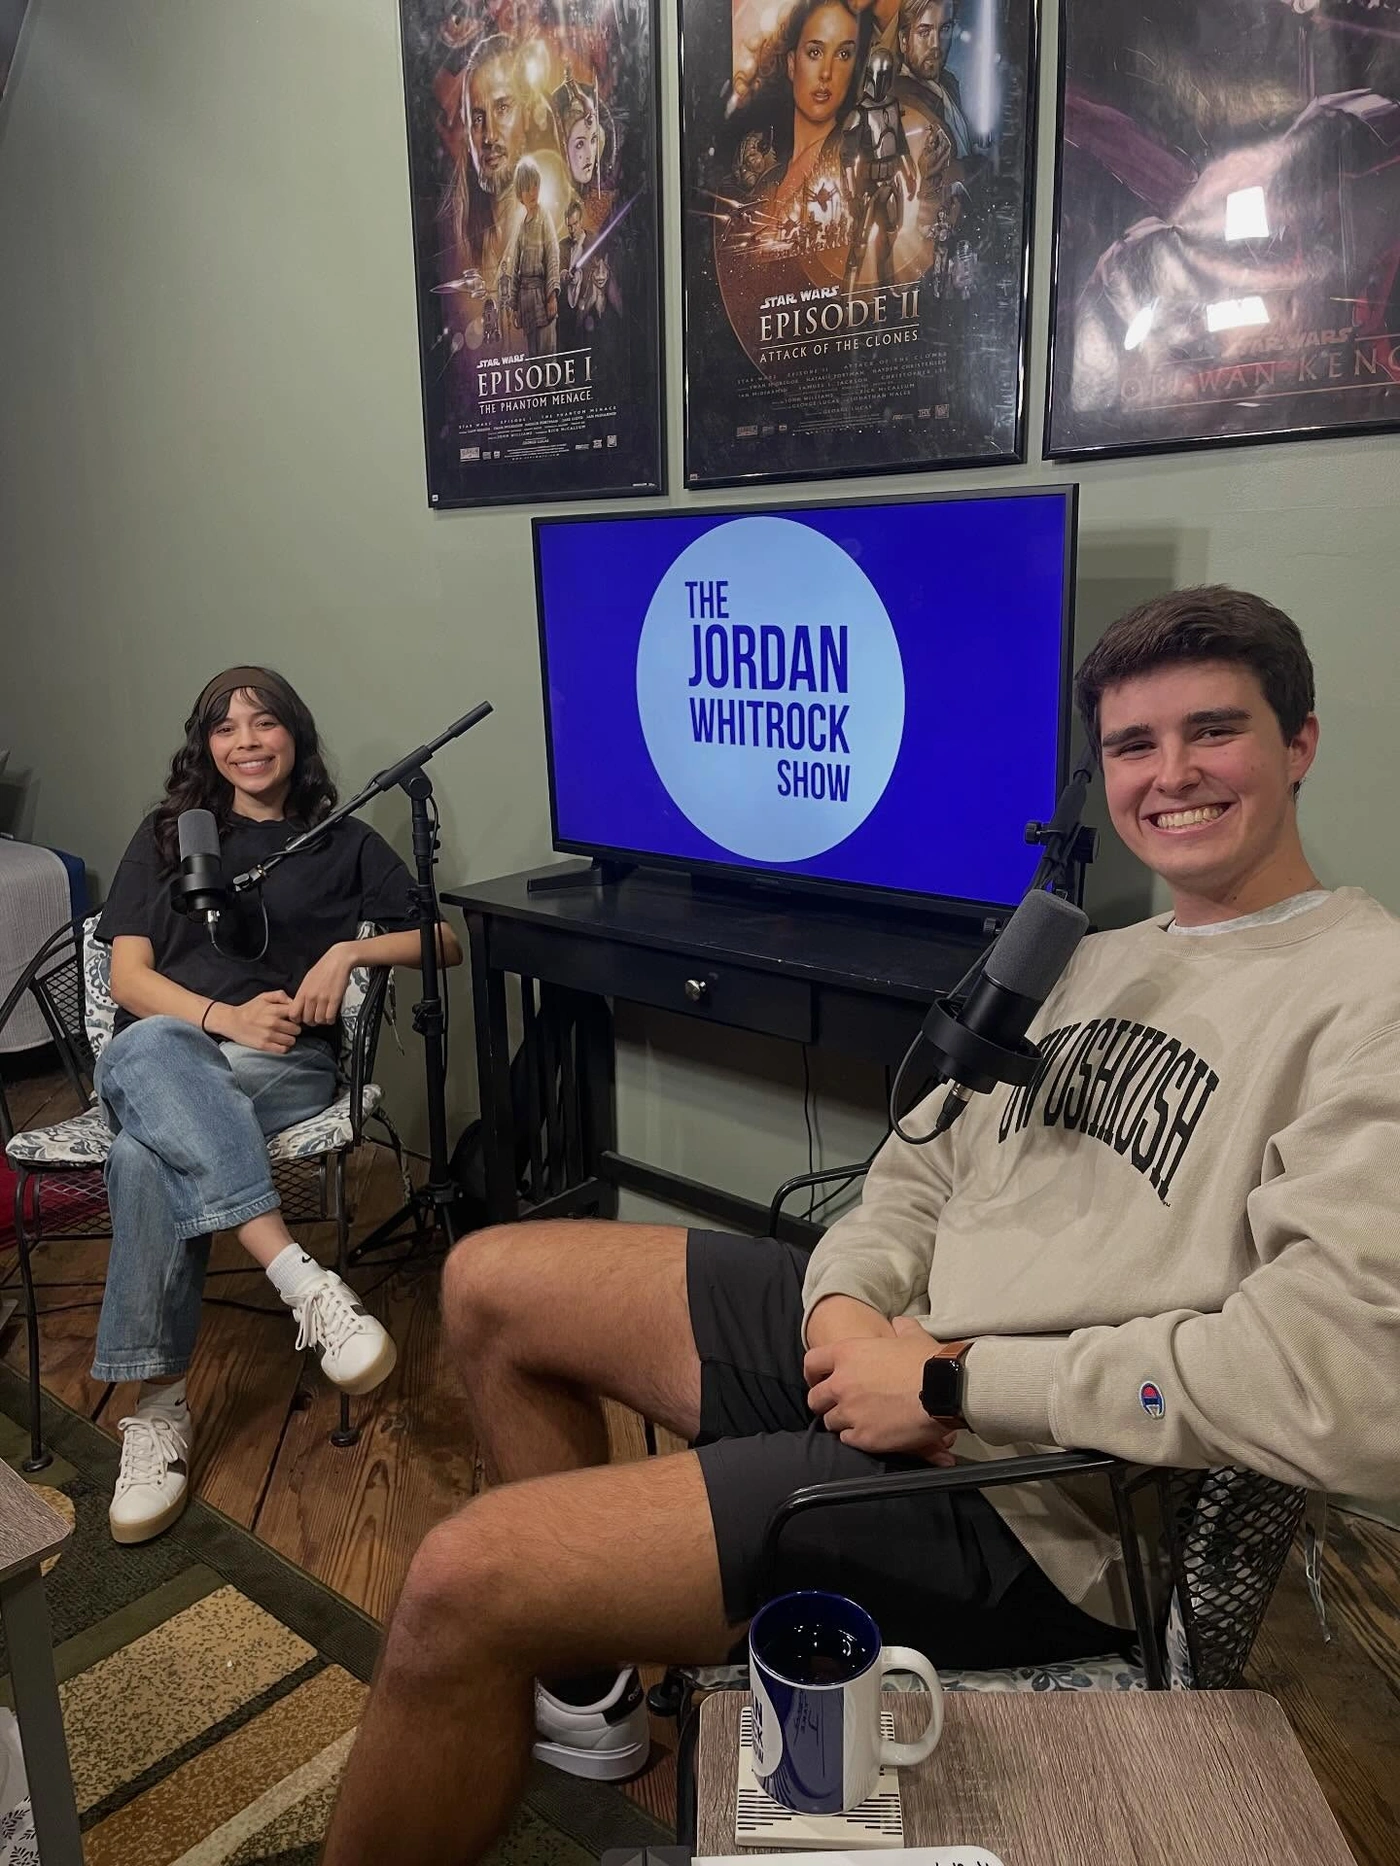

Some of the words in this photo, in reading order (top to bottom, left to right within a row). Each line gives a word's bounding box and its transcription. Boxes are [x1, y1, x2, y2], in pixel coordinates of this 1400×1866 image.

[759, 295, 887, 342] EPISODE
[900, 289, 920, 320] II
[760, 293, 797, 310] STAR
[800, 285, 840, 302] WARS
[476, 359, 500, 369] STAR
[501, 354, 525, 365] WARS
[760, 346, 807, 363] ATTACK
[813, 342, 829, 355] OF
[837, 338, 859, 351] THE
[866, 330, 918, 348] CLONES
[478, 359, 576, 397] EPISODE
[584, 356, 592, 381] I
[480, 403, 496, 415] THE
[500, 396, 547, 412] PHANTOM
[552, 390, 591, 406] MENACE
[684, 580, 730, 619] THE
[688, 624, 849, 694] JORDAN
[688, 697, 851, 754] WHITROCK
[777, 759, 851, 803] SHOW
[1043, 1018, 1220, 1201] OSHKOSH
